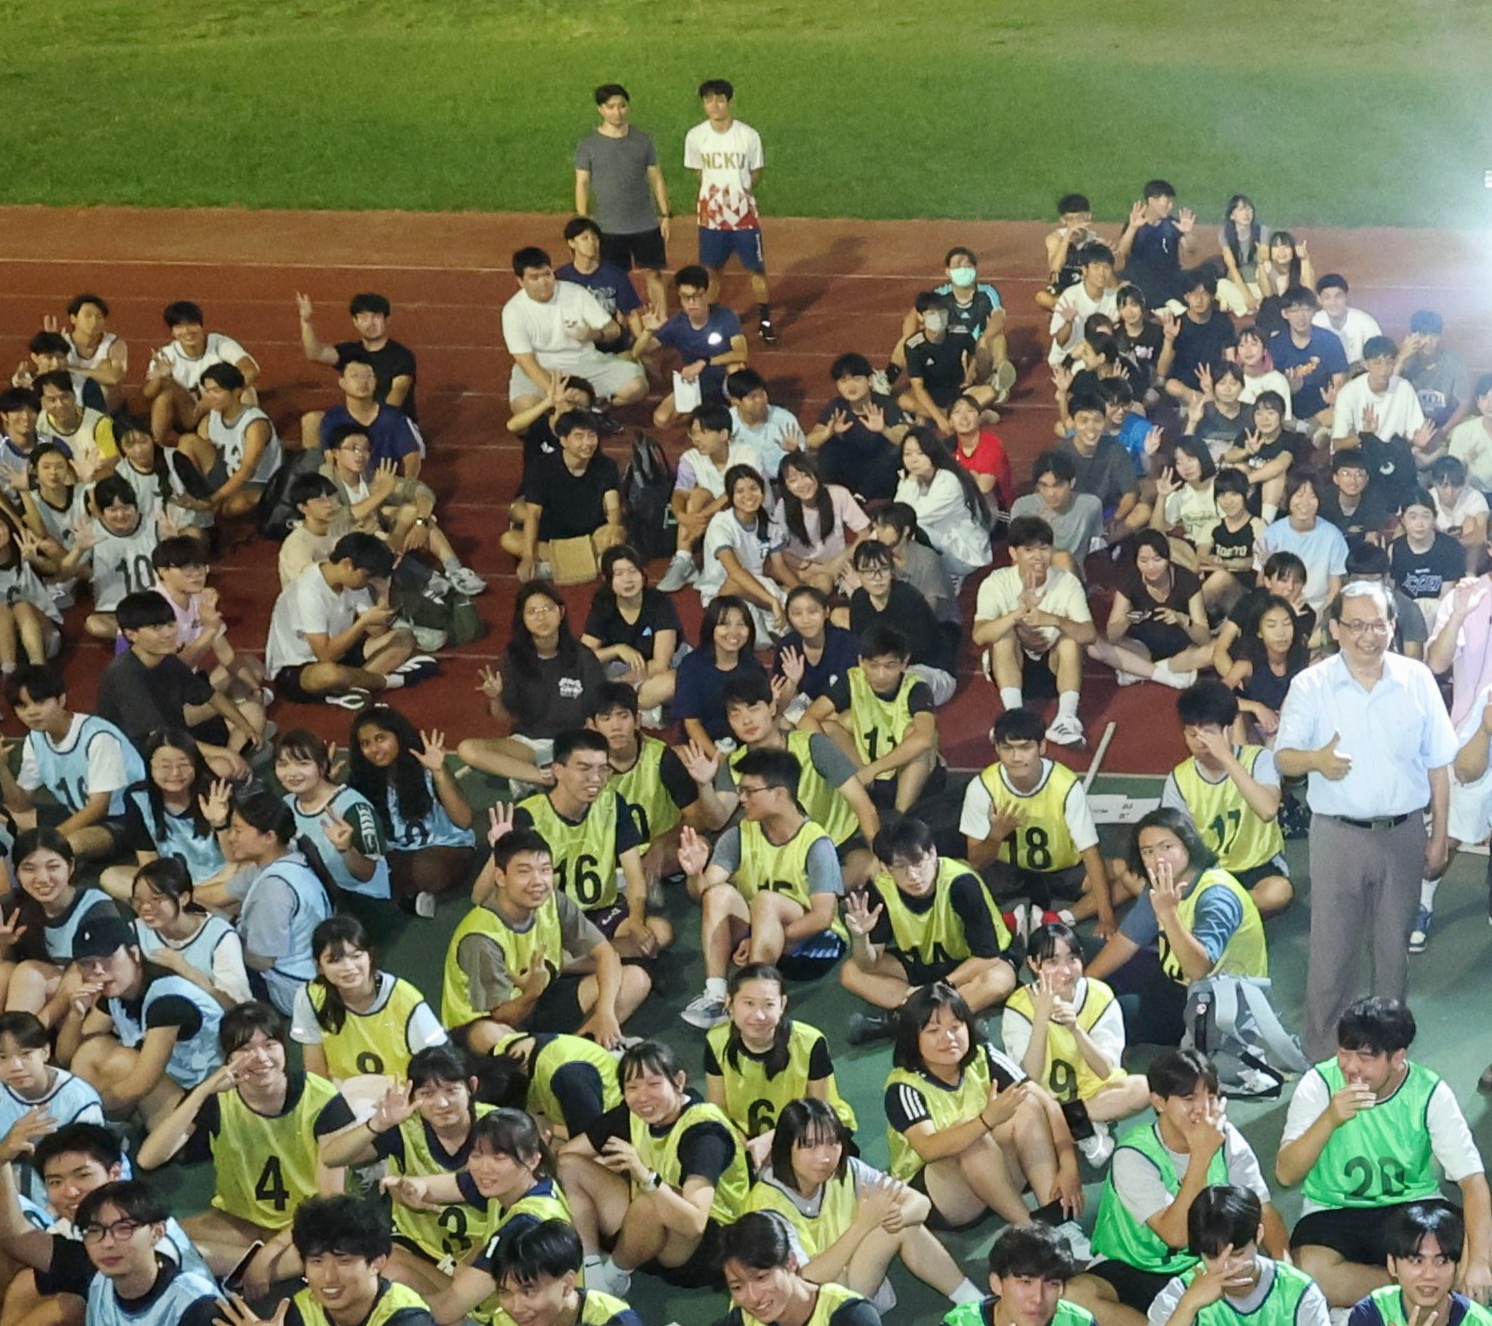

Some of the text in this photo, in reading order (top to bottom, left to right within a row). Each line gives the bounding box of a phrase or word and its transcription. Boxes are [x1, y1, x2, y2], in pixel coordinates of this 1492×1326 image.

[701, 151, 747, 170] NCKU
[115, 554, 154, 593] 10
[1004, 827, 1053, 869] 18
[555, 854, 602, 904] 16
[1049, 1058, 1077, 1102] 9
[255, 1156, 287, 1211] 4
[438, 1206, 472, 1253] 3
